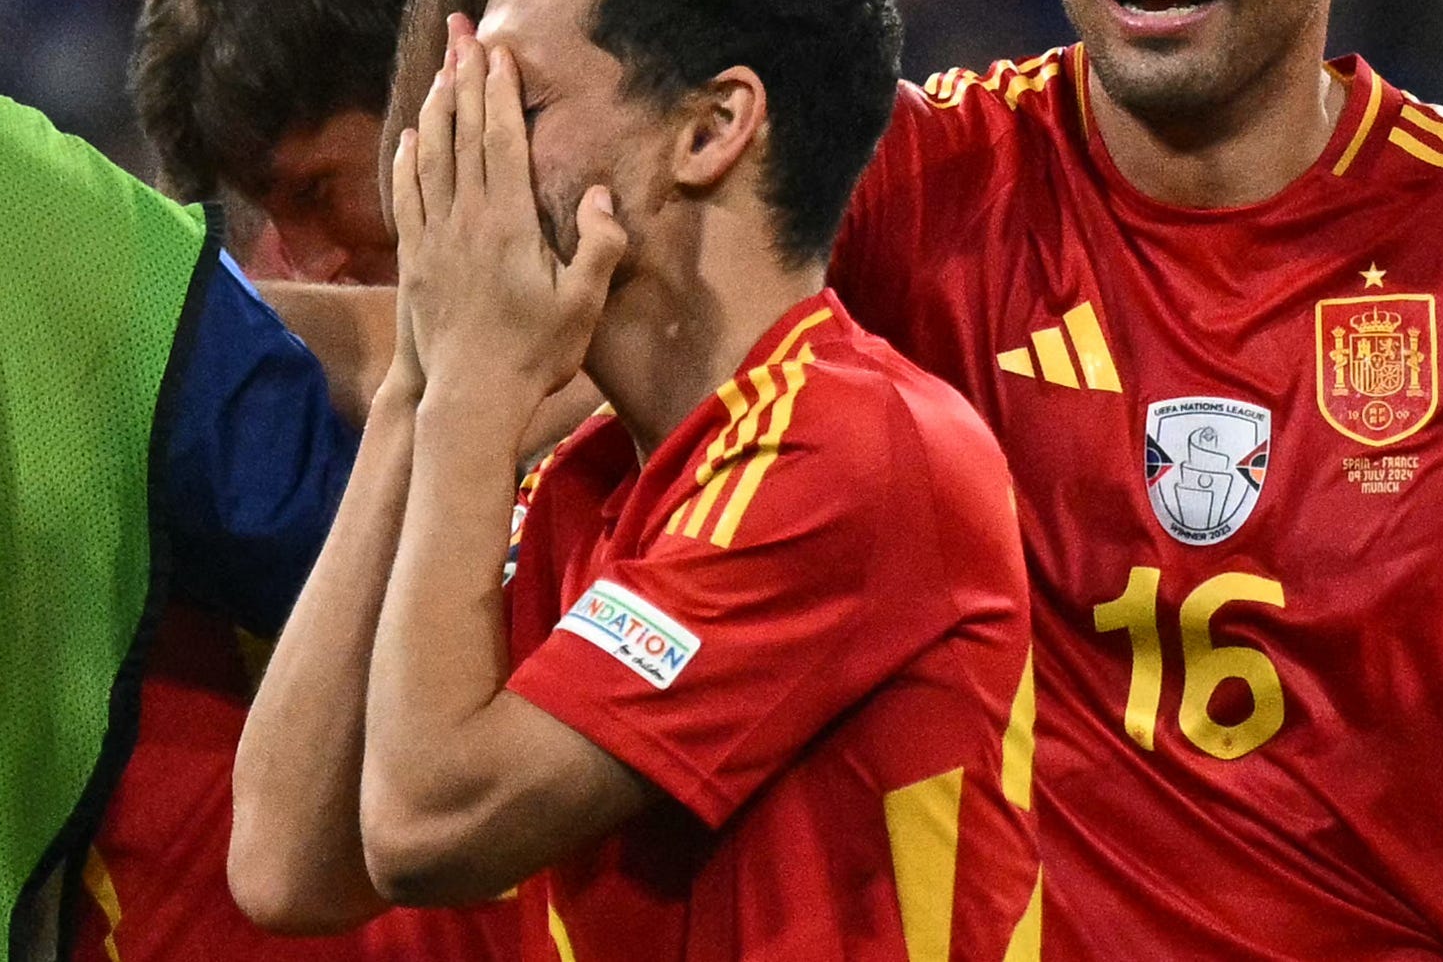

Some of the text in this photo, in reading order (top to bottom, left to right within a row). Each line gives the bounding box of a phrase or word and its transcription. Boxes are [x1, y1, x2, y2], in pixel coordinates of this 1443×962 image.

[1154, 402, 1266, 422] UEFA NATIONS LEAGUE
[1342, 458, 1371, 470] SPAIN
[1381, 456, 1420, 469] FRANCE
[1347, 468, 1414, 482] 09 JULY 2024
[1361, 482, 1401, 494] MUNICH
[1170, 522, 1207, 540] WINNER
[613, 644, 666, 681] for children
[1094, 566, 1285, 760] 16
